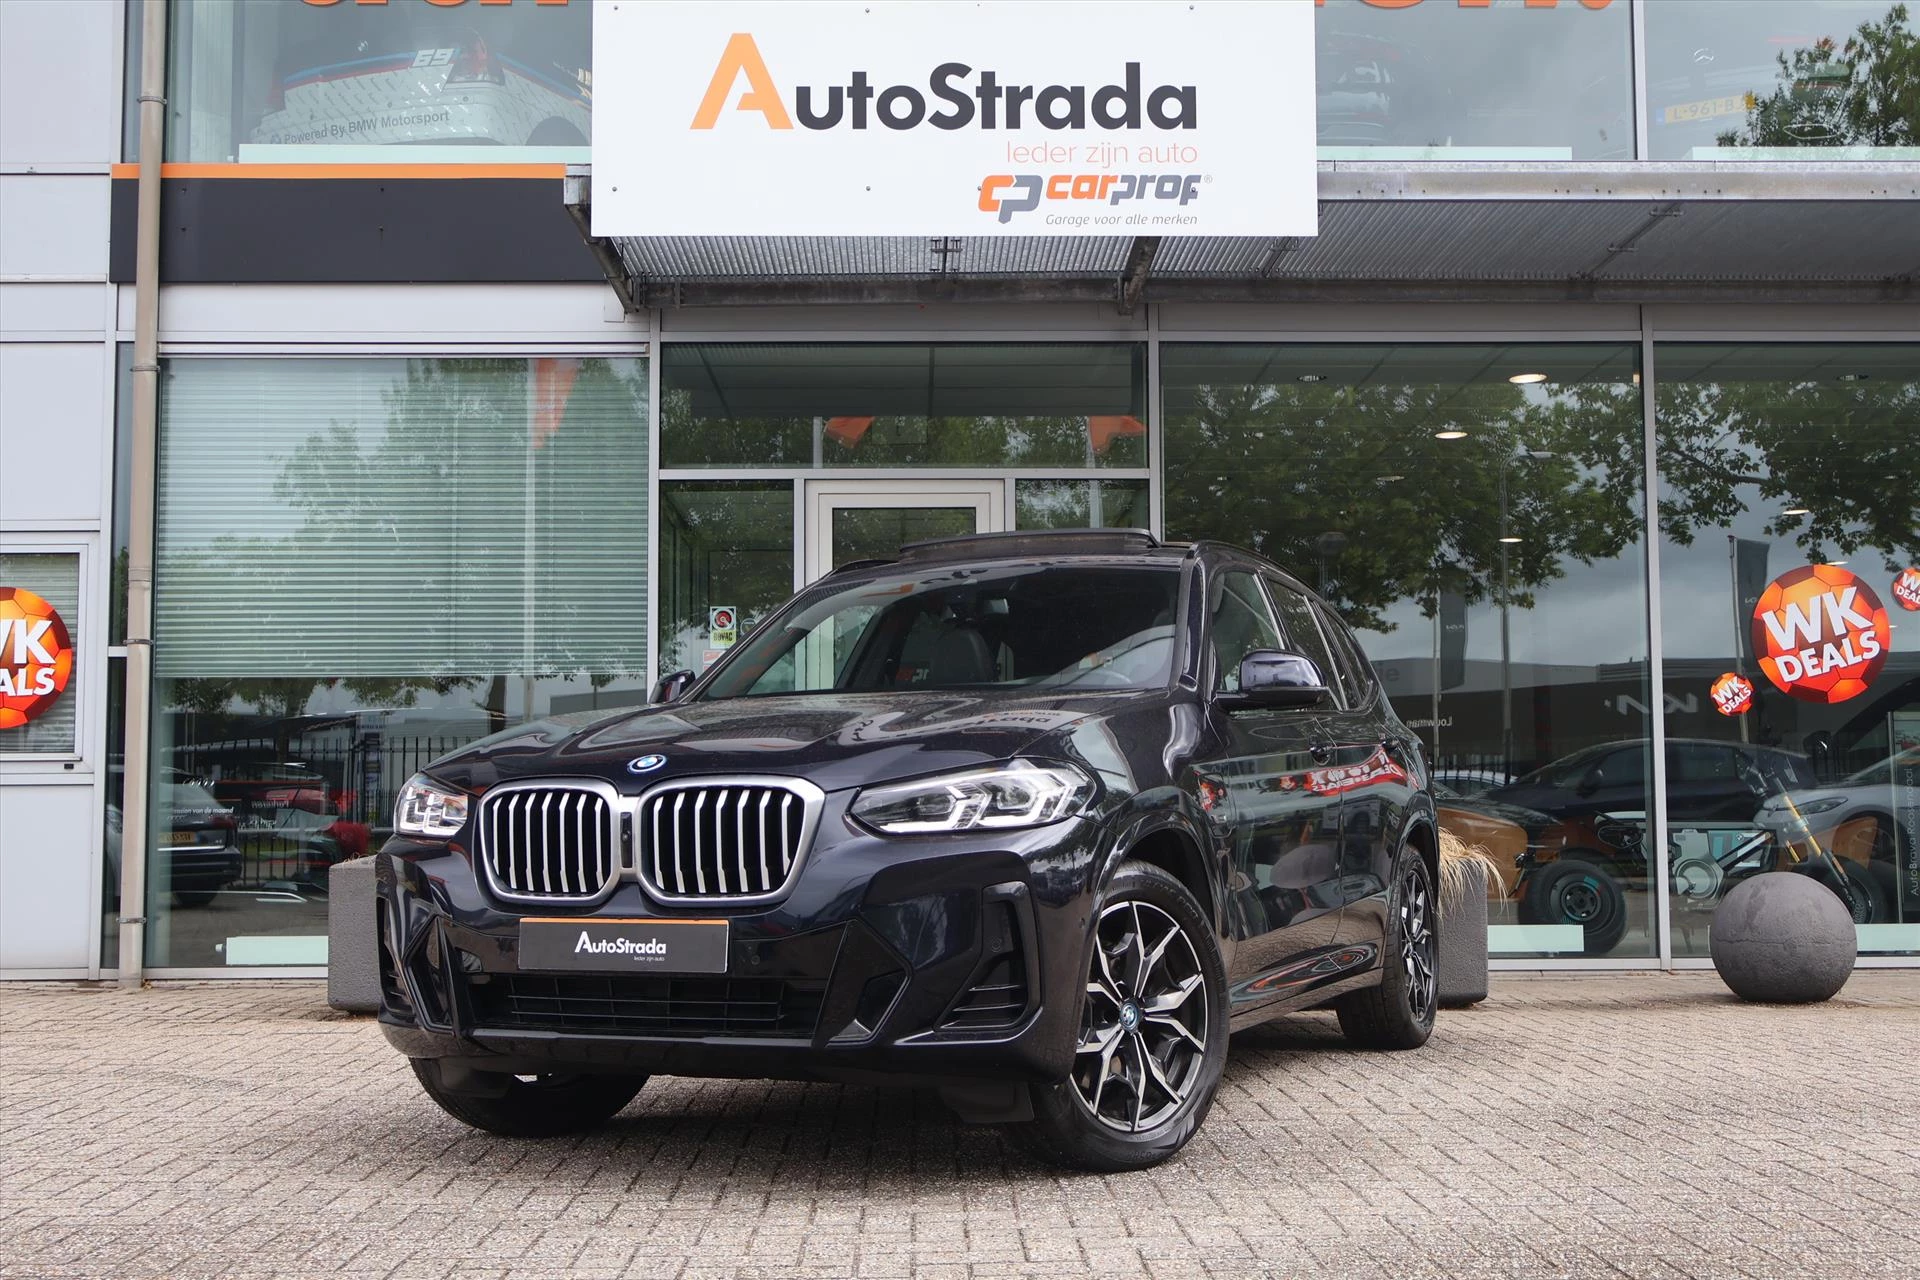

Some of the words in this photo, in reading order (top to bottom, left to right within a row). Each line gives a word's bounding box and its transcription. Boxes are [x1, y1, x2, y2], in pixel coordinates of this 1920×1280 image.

[412, 49, 455, 67] 69
[689, 33, 1198, 131] AutoStrada
[284, 126, 328, 144] Powered
[329, 123, 347, 140] By
[348, 119, 378, 134] BMW
[380, 111, 451, 129] Motorsport
[1006, 141, 1077, 164] Ieder
[1086, 142, 1129, 169] zijn
[1138, 145, 1199, 164] auto
[1045, 174, 1202, 206] carprof
[1045, 214, 1090, 228] Garage
[1091, 215, 1122, 226] voor
[1125, 214, 1149, 226] alle
[1151, 214, 1198, 226] merken
[1902, 572, 1920, 594] W
[1761, 586, 1874, 651] WK
[1774, 630, 1881, 683] DEALS
[0, 667, 56, 697] ALS
[1712, 676, 1746, 704] WK
[1722, 686, 1752, 713] DEALS
[574, 930, 667, 955] AutoStrada
